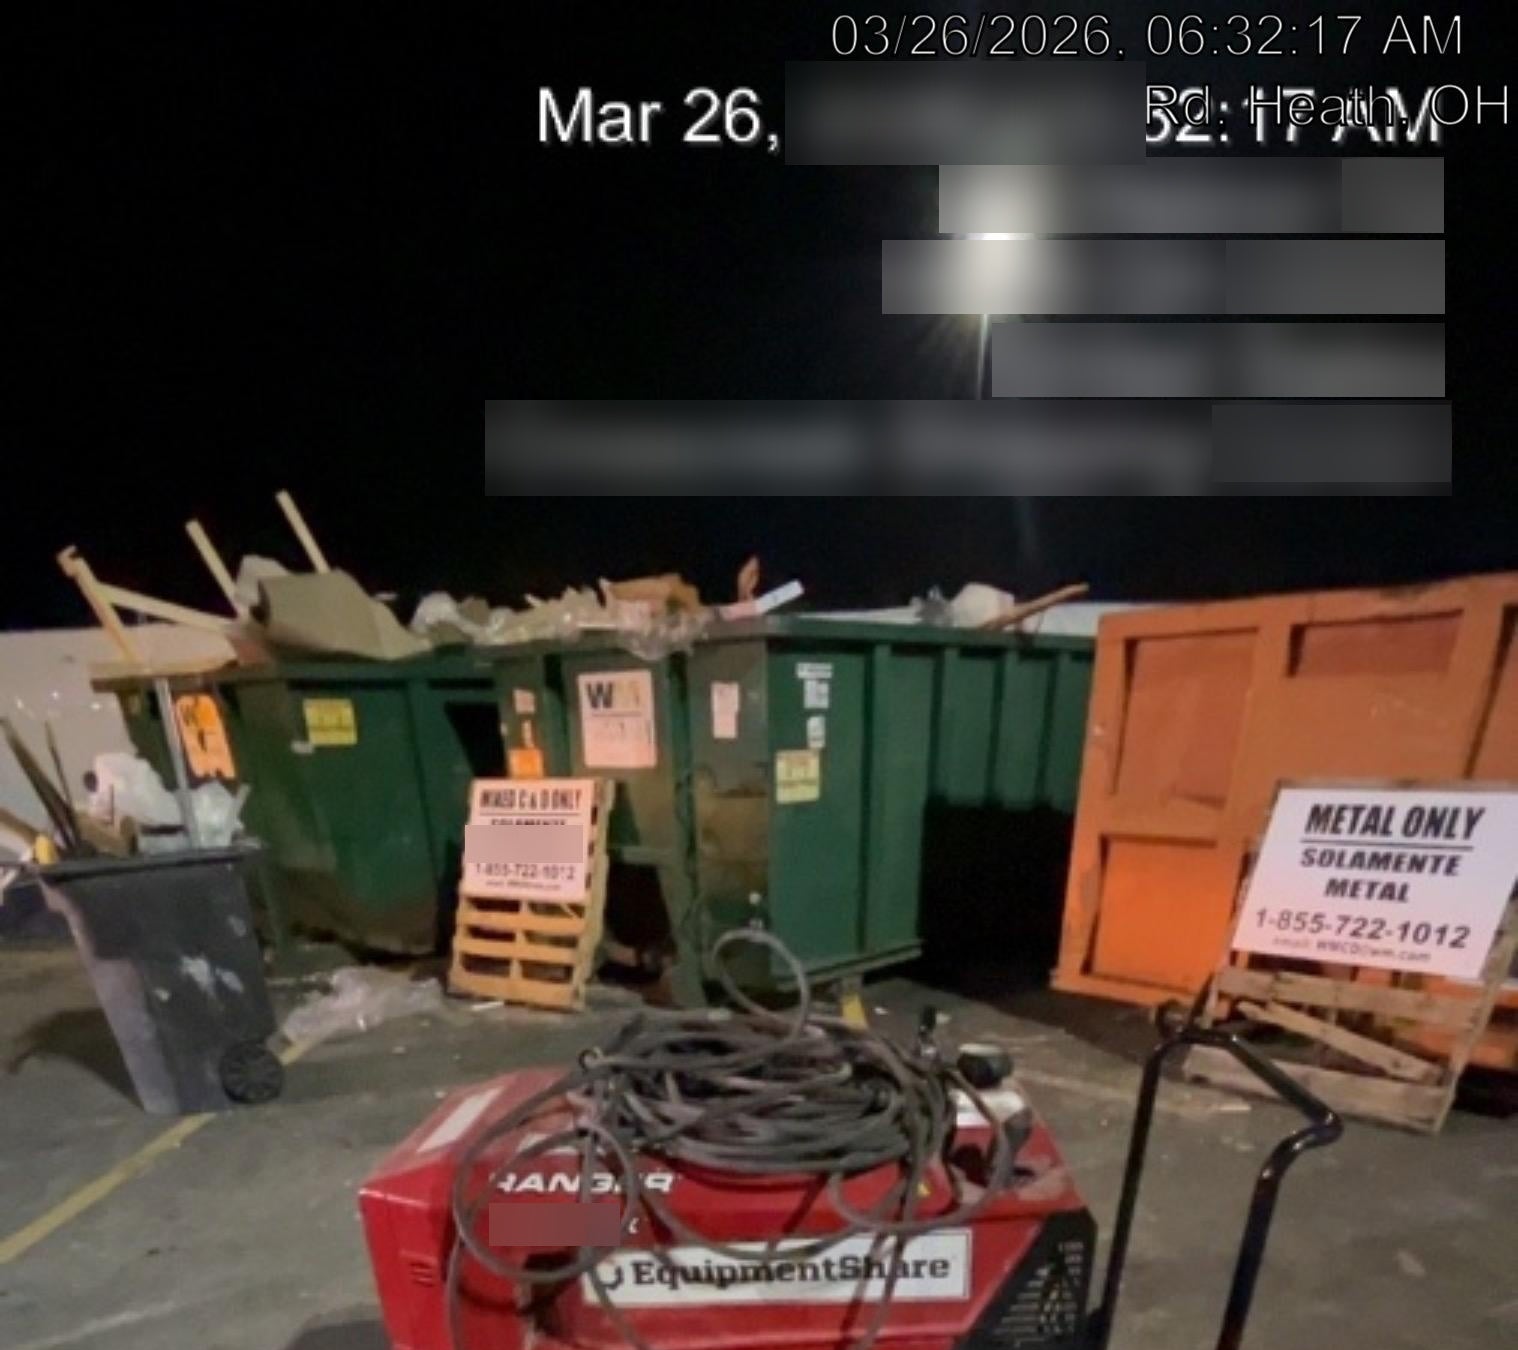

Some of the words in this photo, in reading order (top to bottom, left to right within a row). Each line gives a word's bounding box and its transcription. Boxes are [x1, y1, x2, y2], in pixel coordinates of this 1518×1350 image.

[1305, 803, 1395, 837] METAL
[1402, 806, 1485, 840] ONLY
[1301, 849, 1463, 876] SOLAMENTE
[1324, 878, 1410, 903] METAL
[1255, 908, 1472, 949] 1-855-722-1012
[631, 1255, 950, 1290] EquipmentShare
